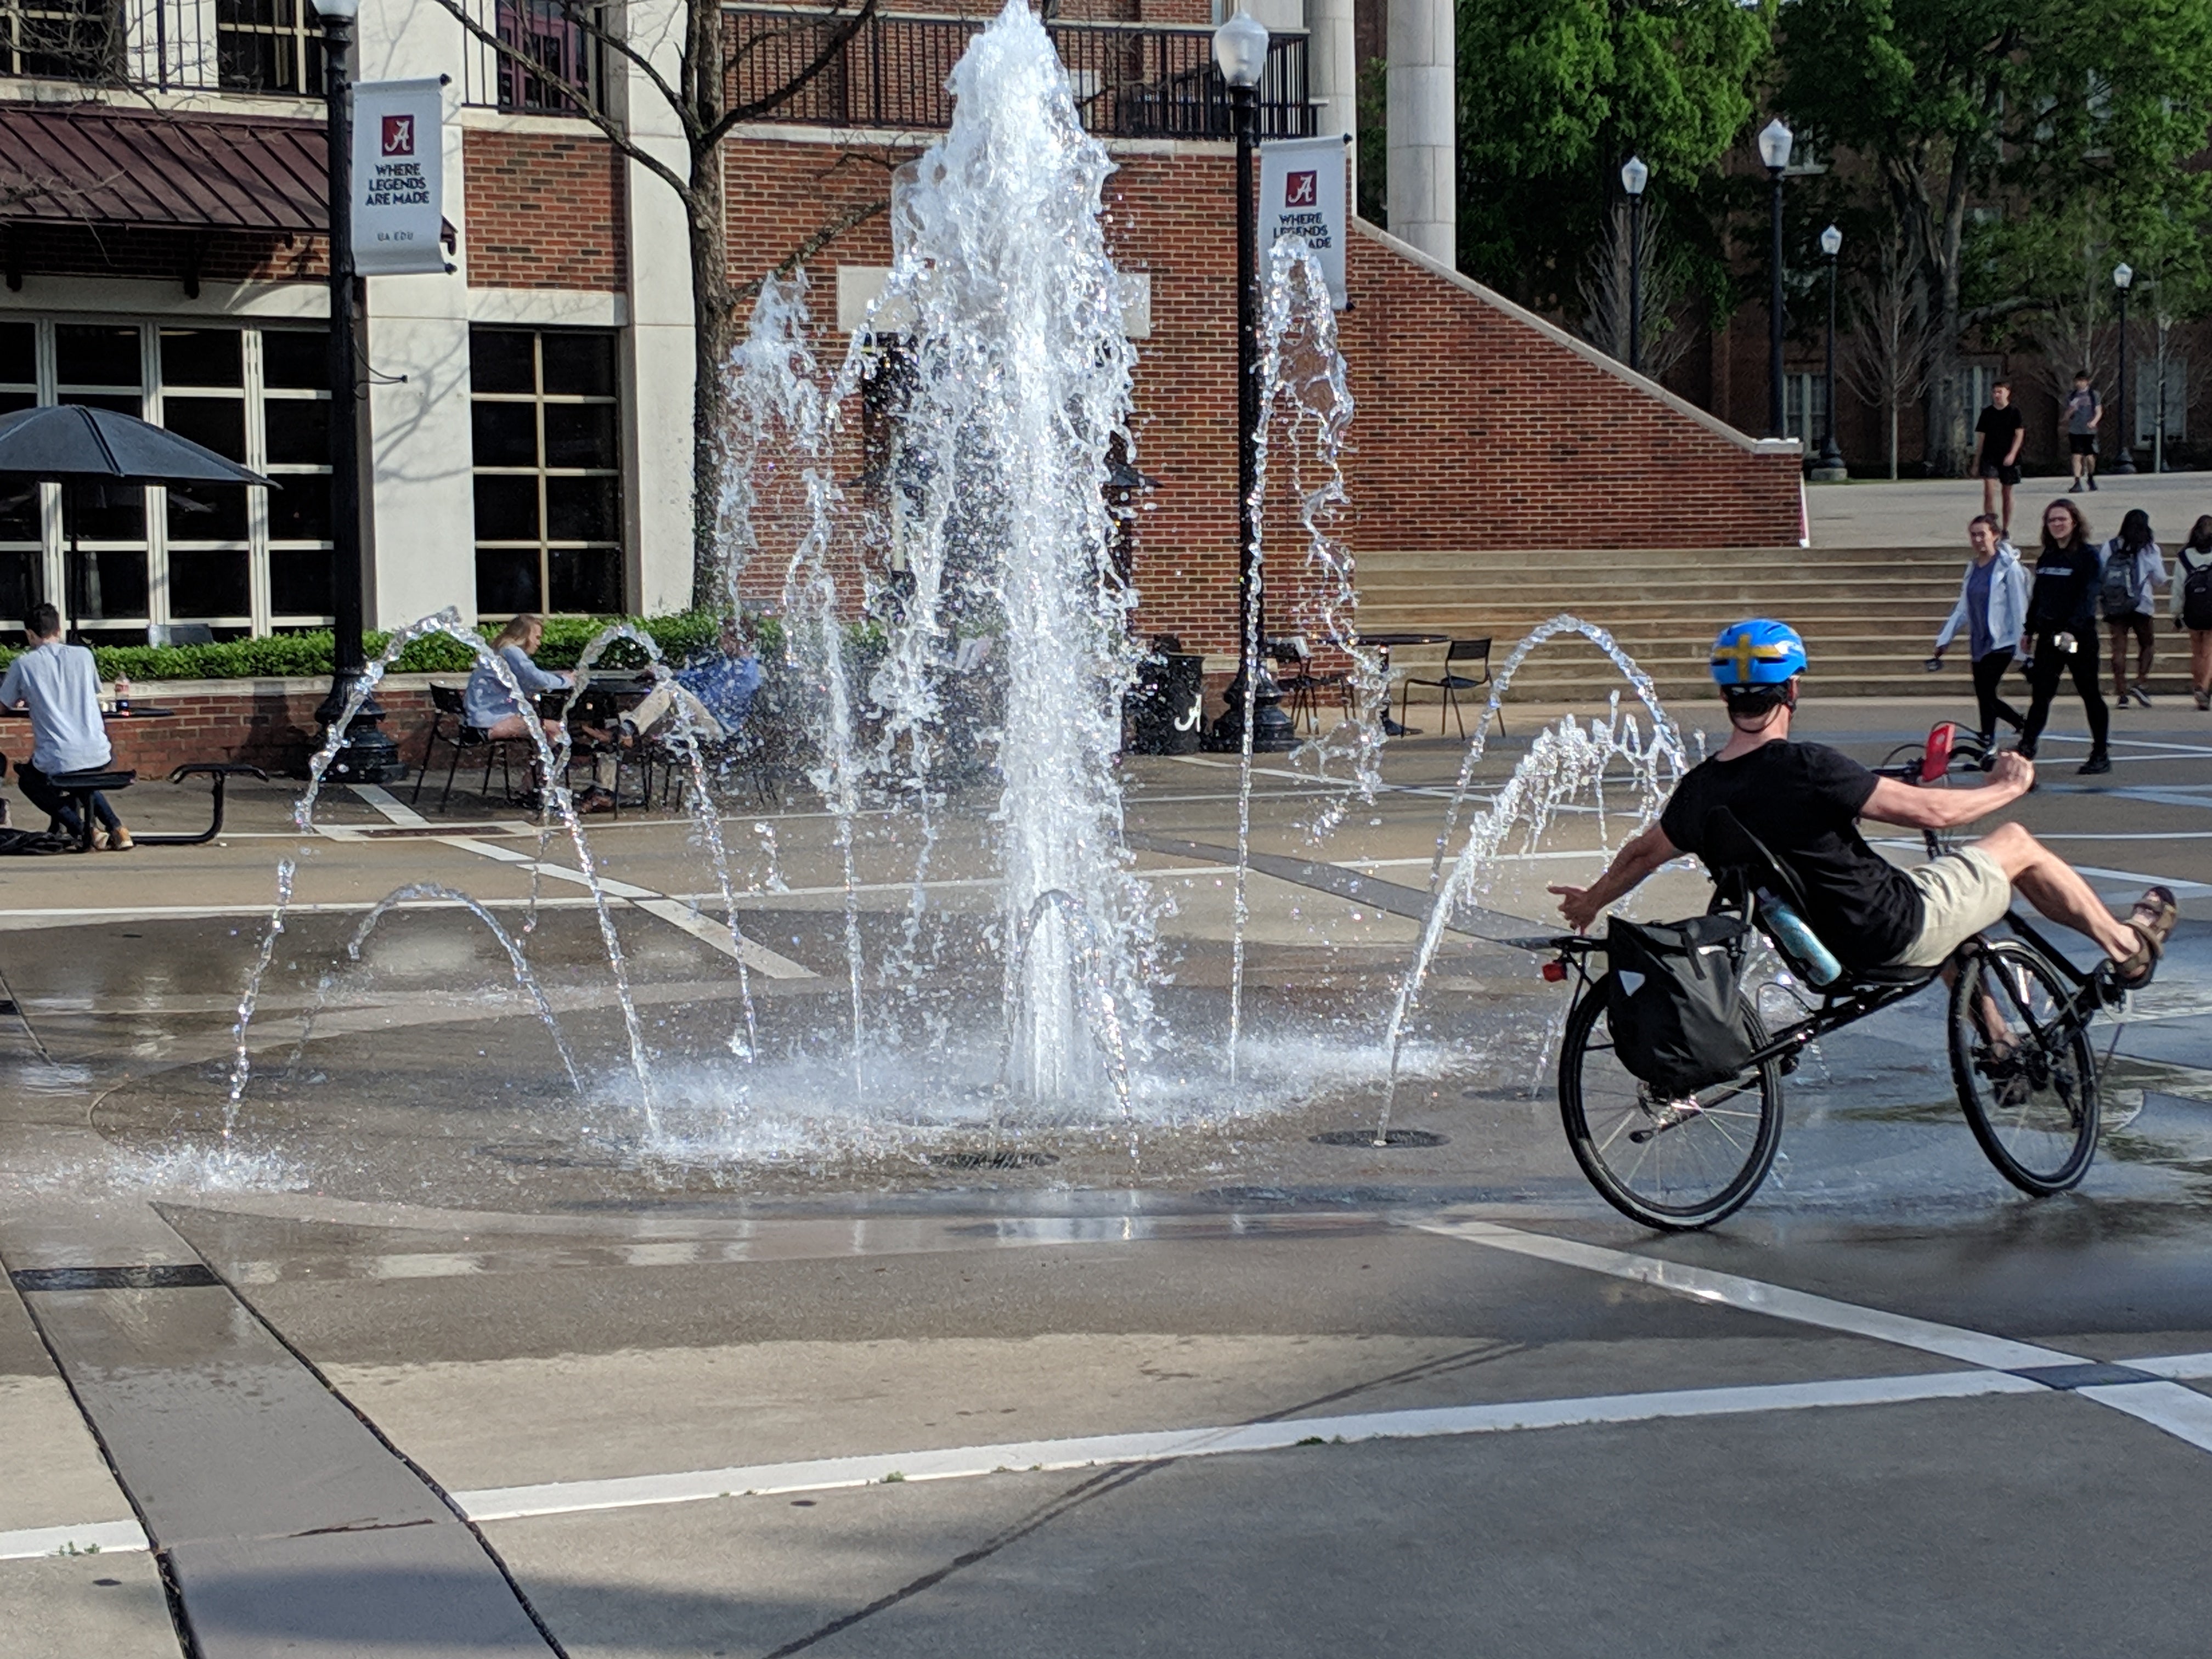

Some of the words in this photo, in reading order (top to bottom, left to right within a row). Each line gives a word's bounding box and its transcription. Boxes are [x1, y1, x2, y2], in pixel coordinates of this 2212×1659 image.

[385, 120, 411, 152] A
[375, 163, 421, 176] WHERE
[368, 177, 426, 191] LEGENDS
[1288, 174, 1313, 203] A
[365, 193, 391, 206] ARE
[393, 191, 430, 204] MADE
[1279, 212, 1322, 225] WHERE
[1307, 237, 1331, 249] ADE
